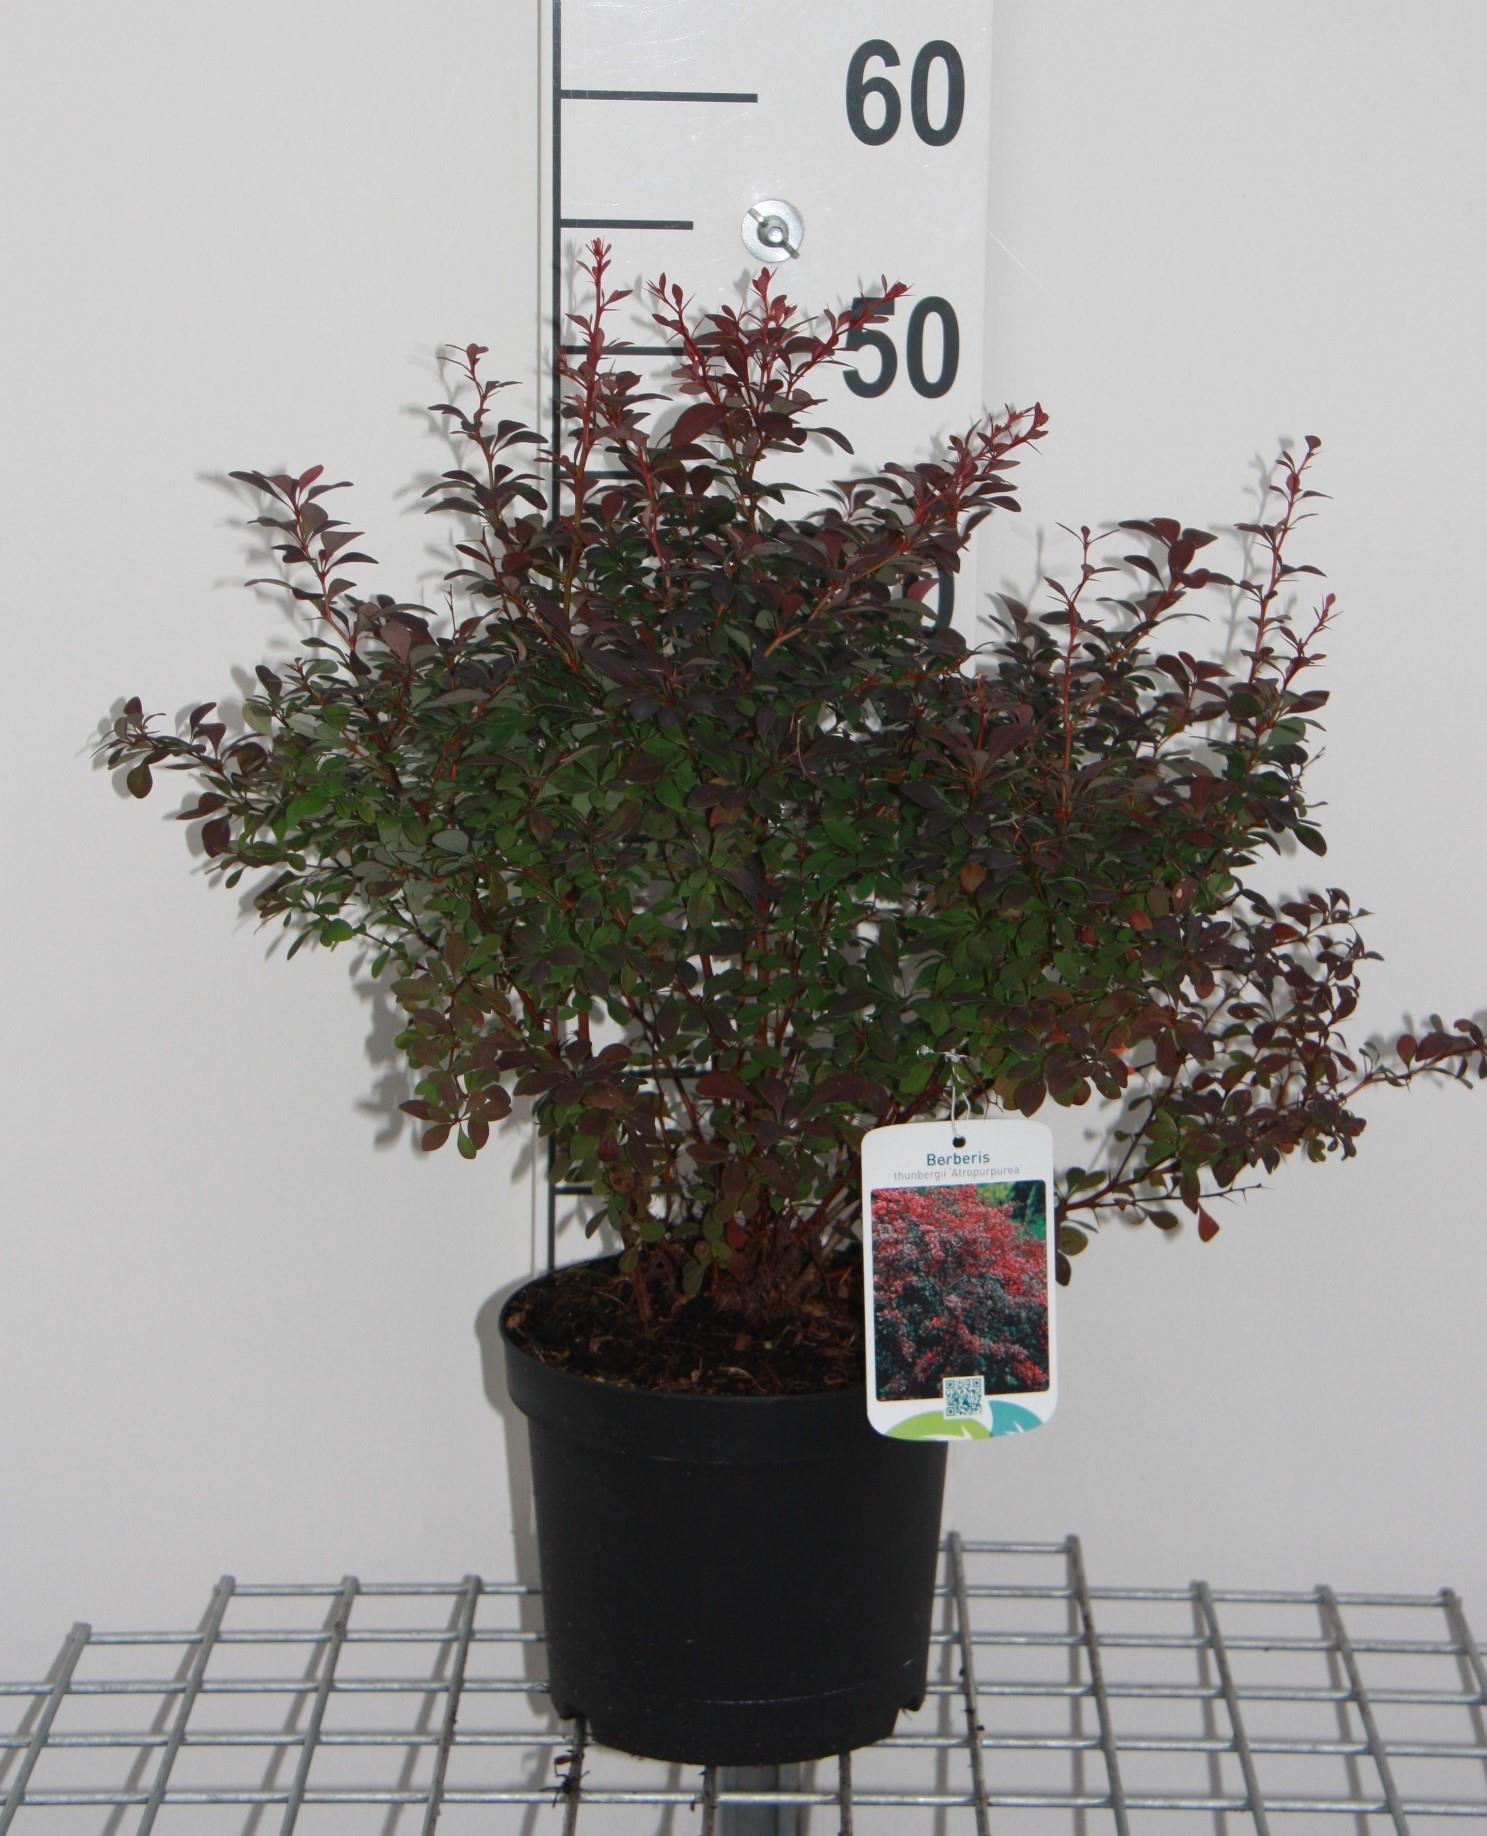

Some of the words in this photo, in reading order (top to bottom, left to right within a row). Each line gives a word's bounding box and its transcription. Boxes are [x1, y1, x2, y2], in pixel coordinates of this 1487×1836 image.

[846, 39, 964, 146] 60
[842, 295, 960, 399] 50
[893, 1169, 946, 1182] thunbergii
[926, 1151, 991, 1167] Berberis
